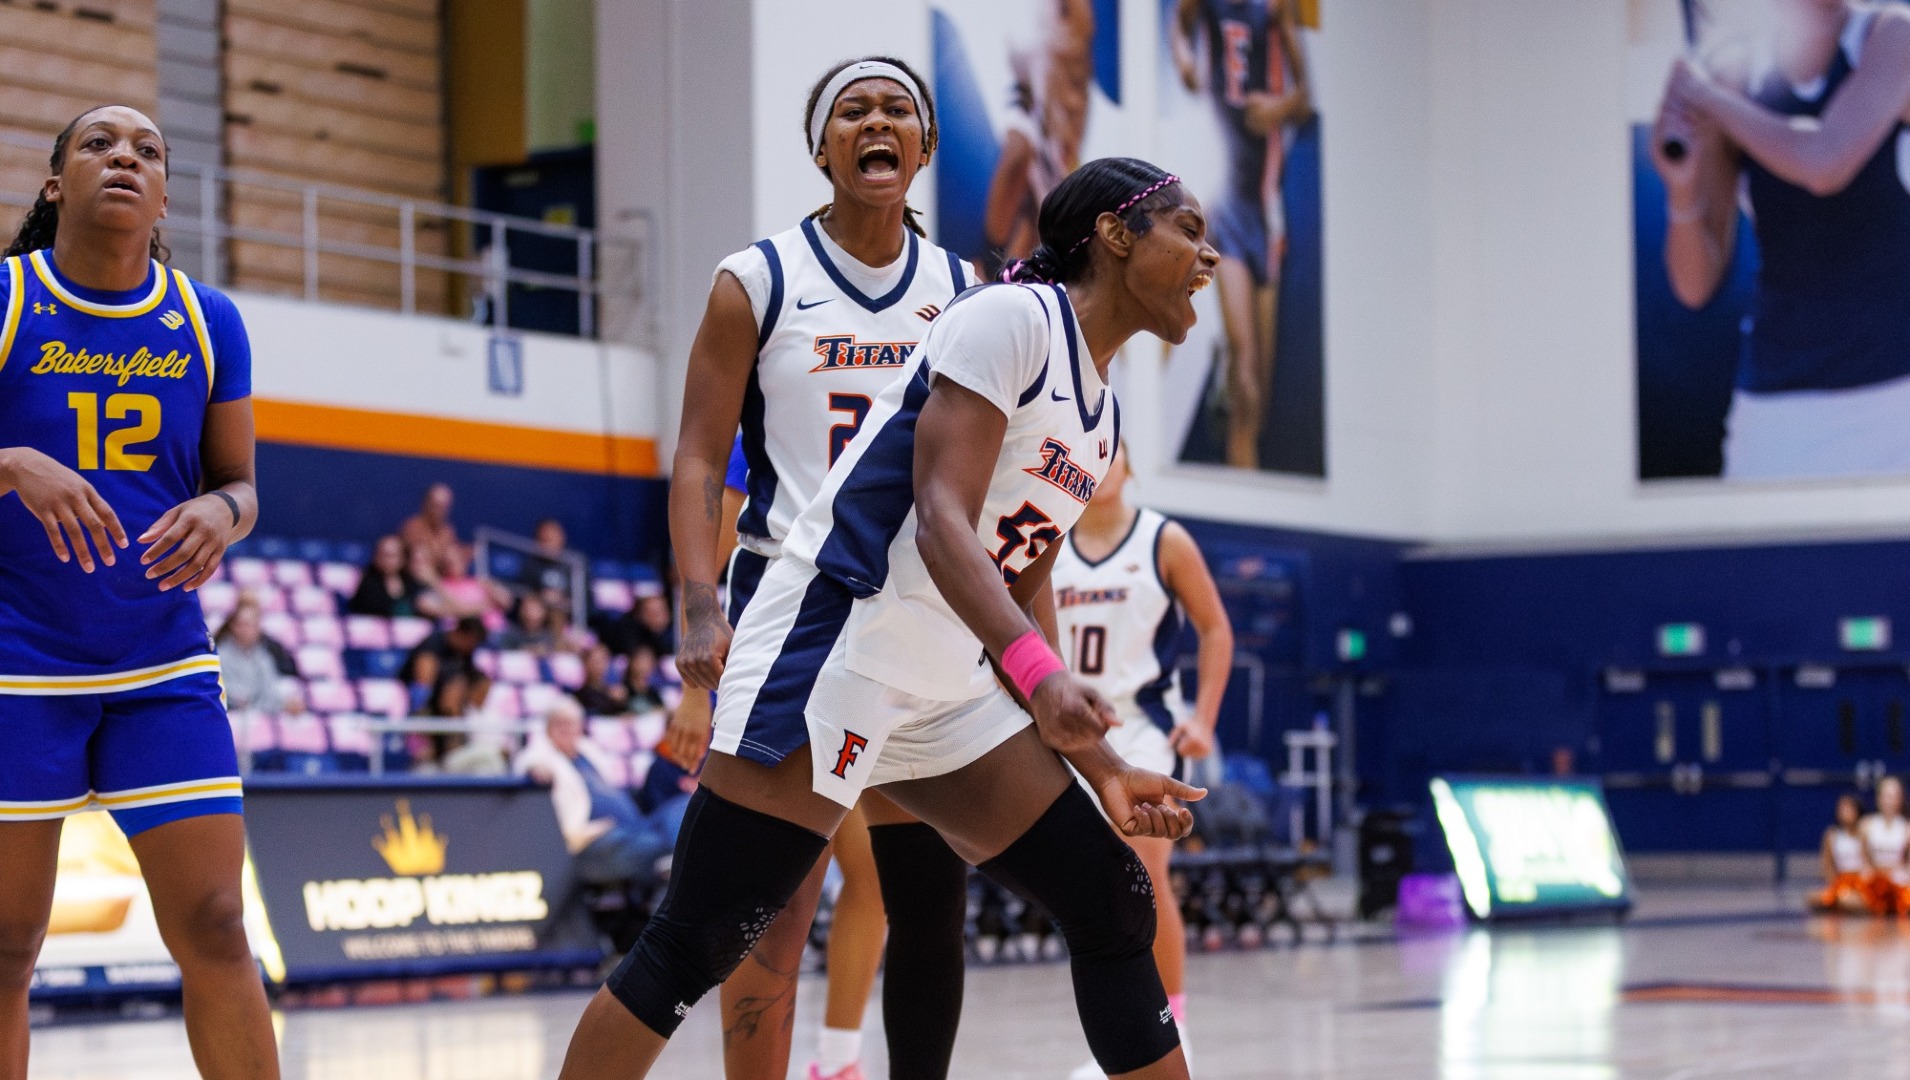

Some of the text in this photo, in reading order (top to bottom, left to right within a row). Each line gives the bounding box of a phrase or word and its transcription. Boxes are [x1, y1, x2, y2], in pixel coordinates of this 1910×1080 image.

[30, 340, 192, 387] Bakersfield
[812, 335, 918, 370] TITAN
[67, 392, 162, 472] 12
[830, 728, 868, 780] F
[303, 877, 425, 931] HOOP
